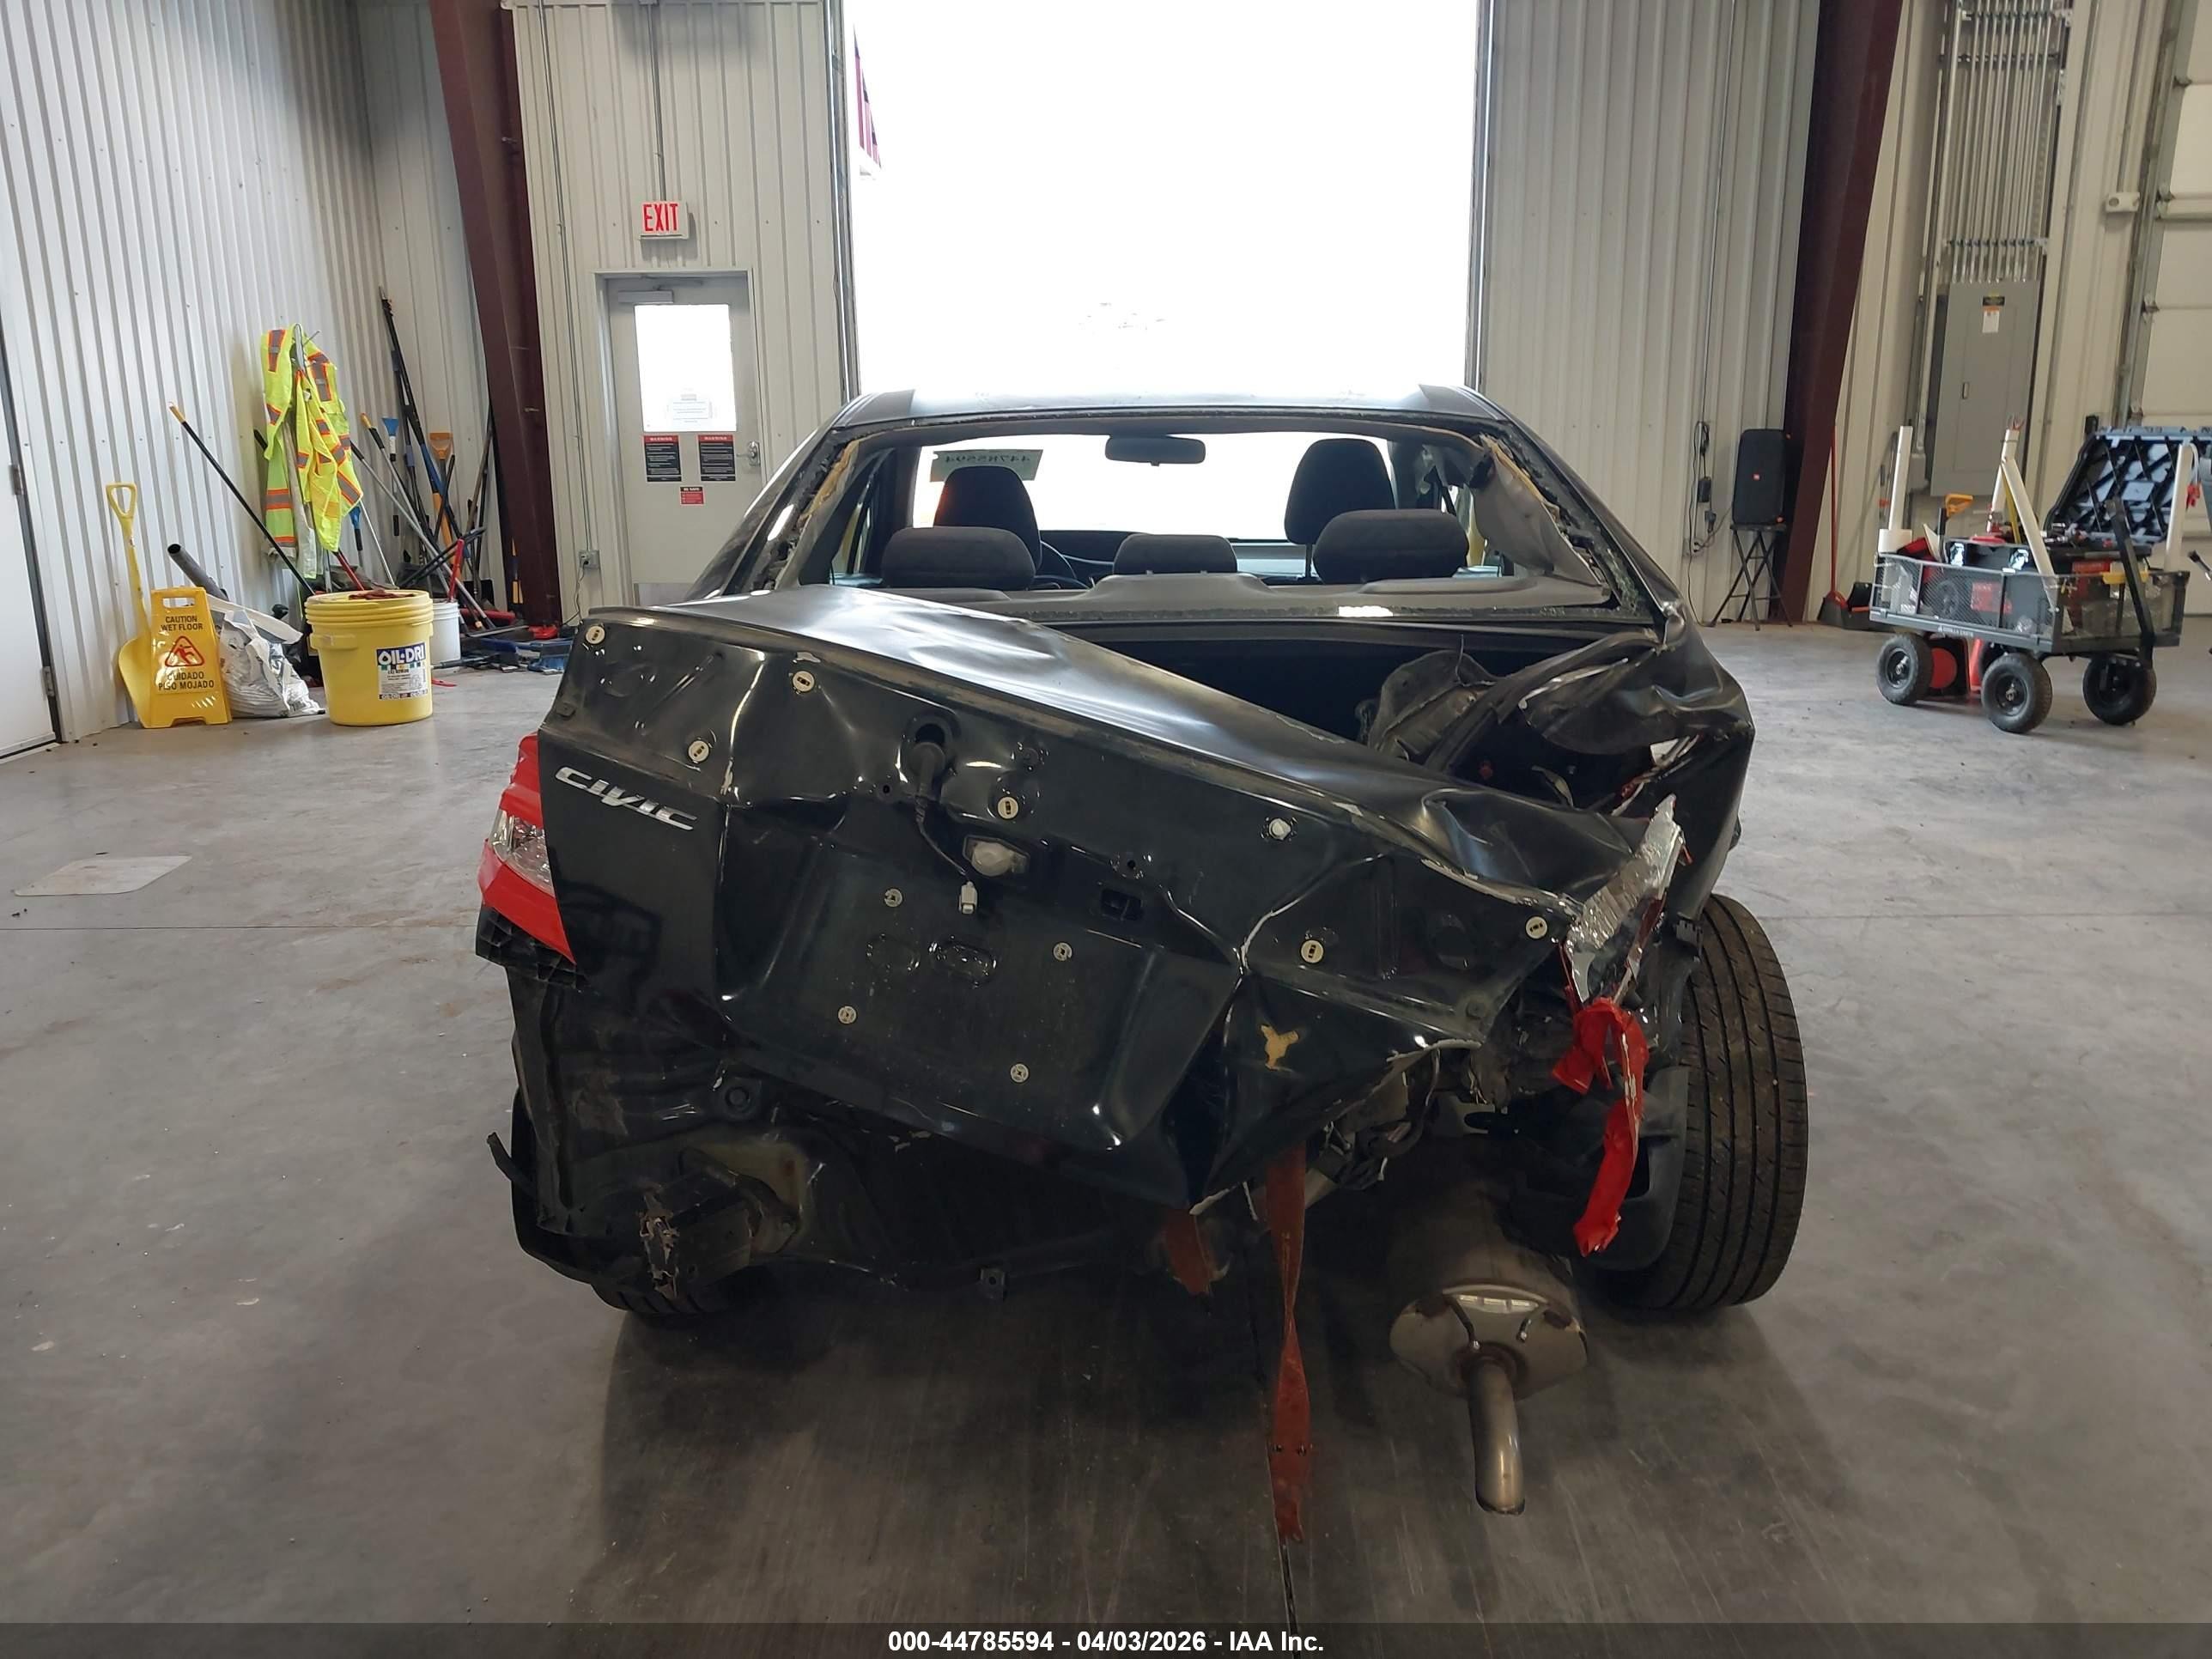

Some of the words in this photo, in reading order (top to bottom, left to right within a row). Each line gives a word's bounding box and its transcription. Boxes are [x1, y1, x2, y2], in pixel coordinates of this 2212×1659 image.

[642, 203, 678, 232] EXIT
[167, 671, 204, 681] CUIDADO
[179, 680, 214, 689] MOJADO
[555, 766, 698, 831] CIVIC
